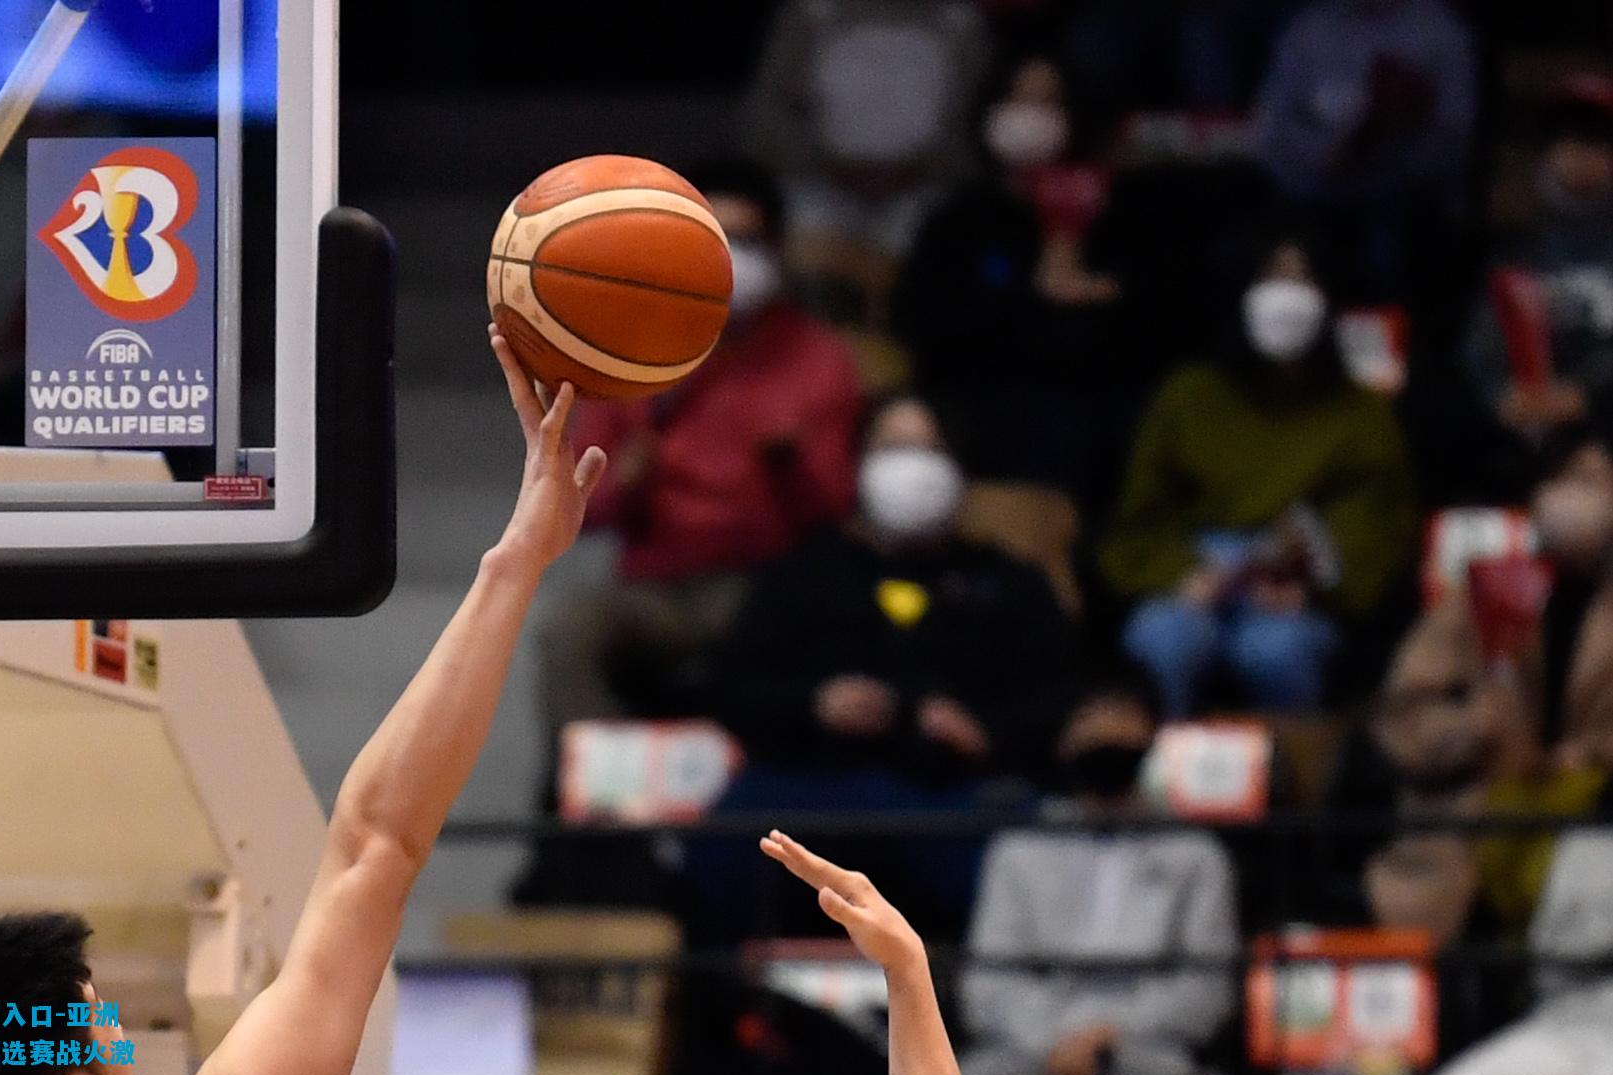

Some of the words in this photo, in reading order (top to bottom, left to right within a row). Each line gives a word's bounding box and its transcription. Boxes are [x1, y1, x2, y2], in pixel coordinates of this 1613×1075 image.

[100, 344, 139, 363] FIBA
[31, 369, 204, 382] BASKETBALL
[30, 385, 141, 409] WORLD
[148, 384, 209, 409] CUP
[33, 415, 205, 439] QUALIFIERS
